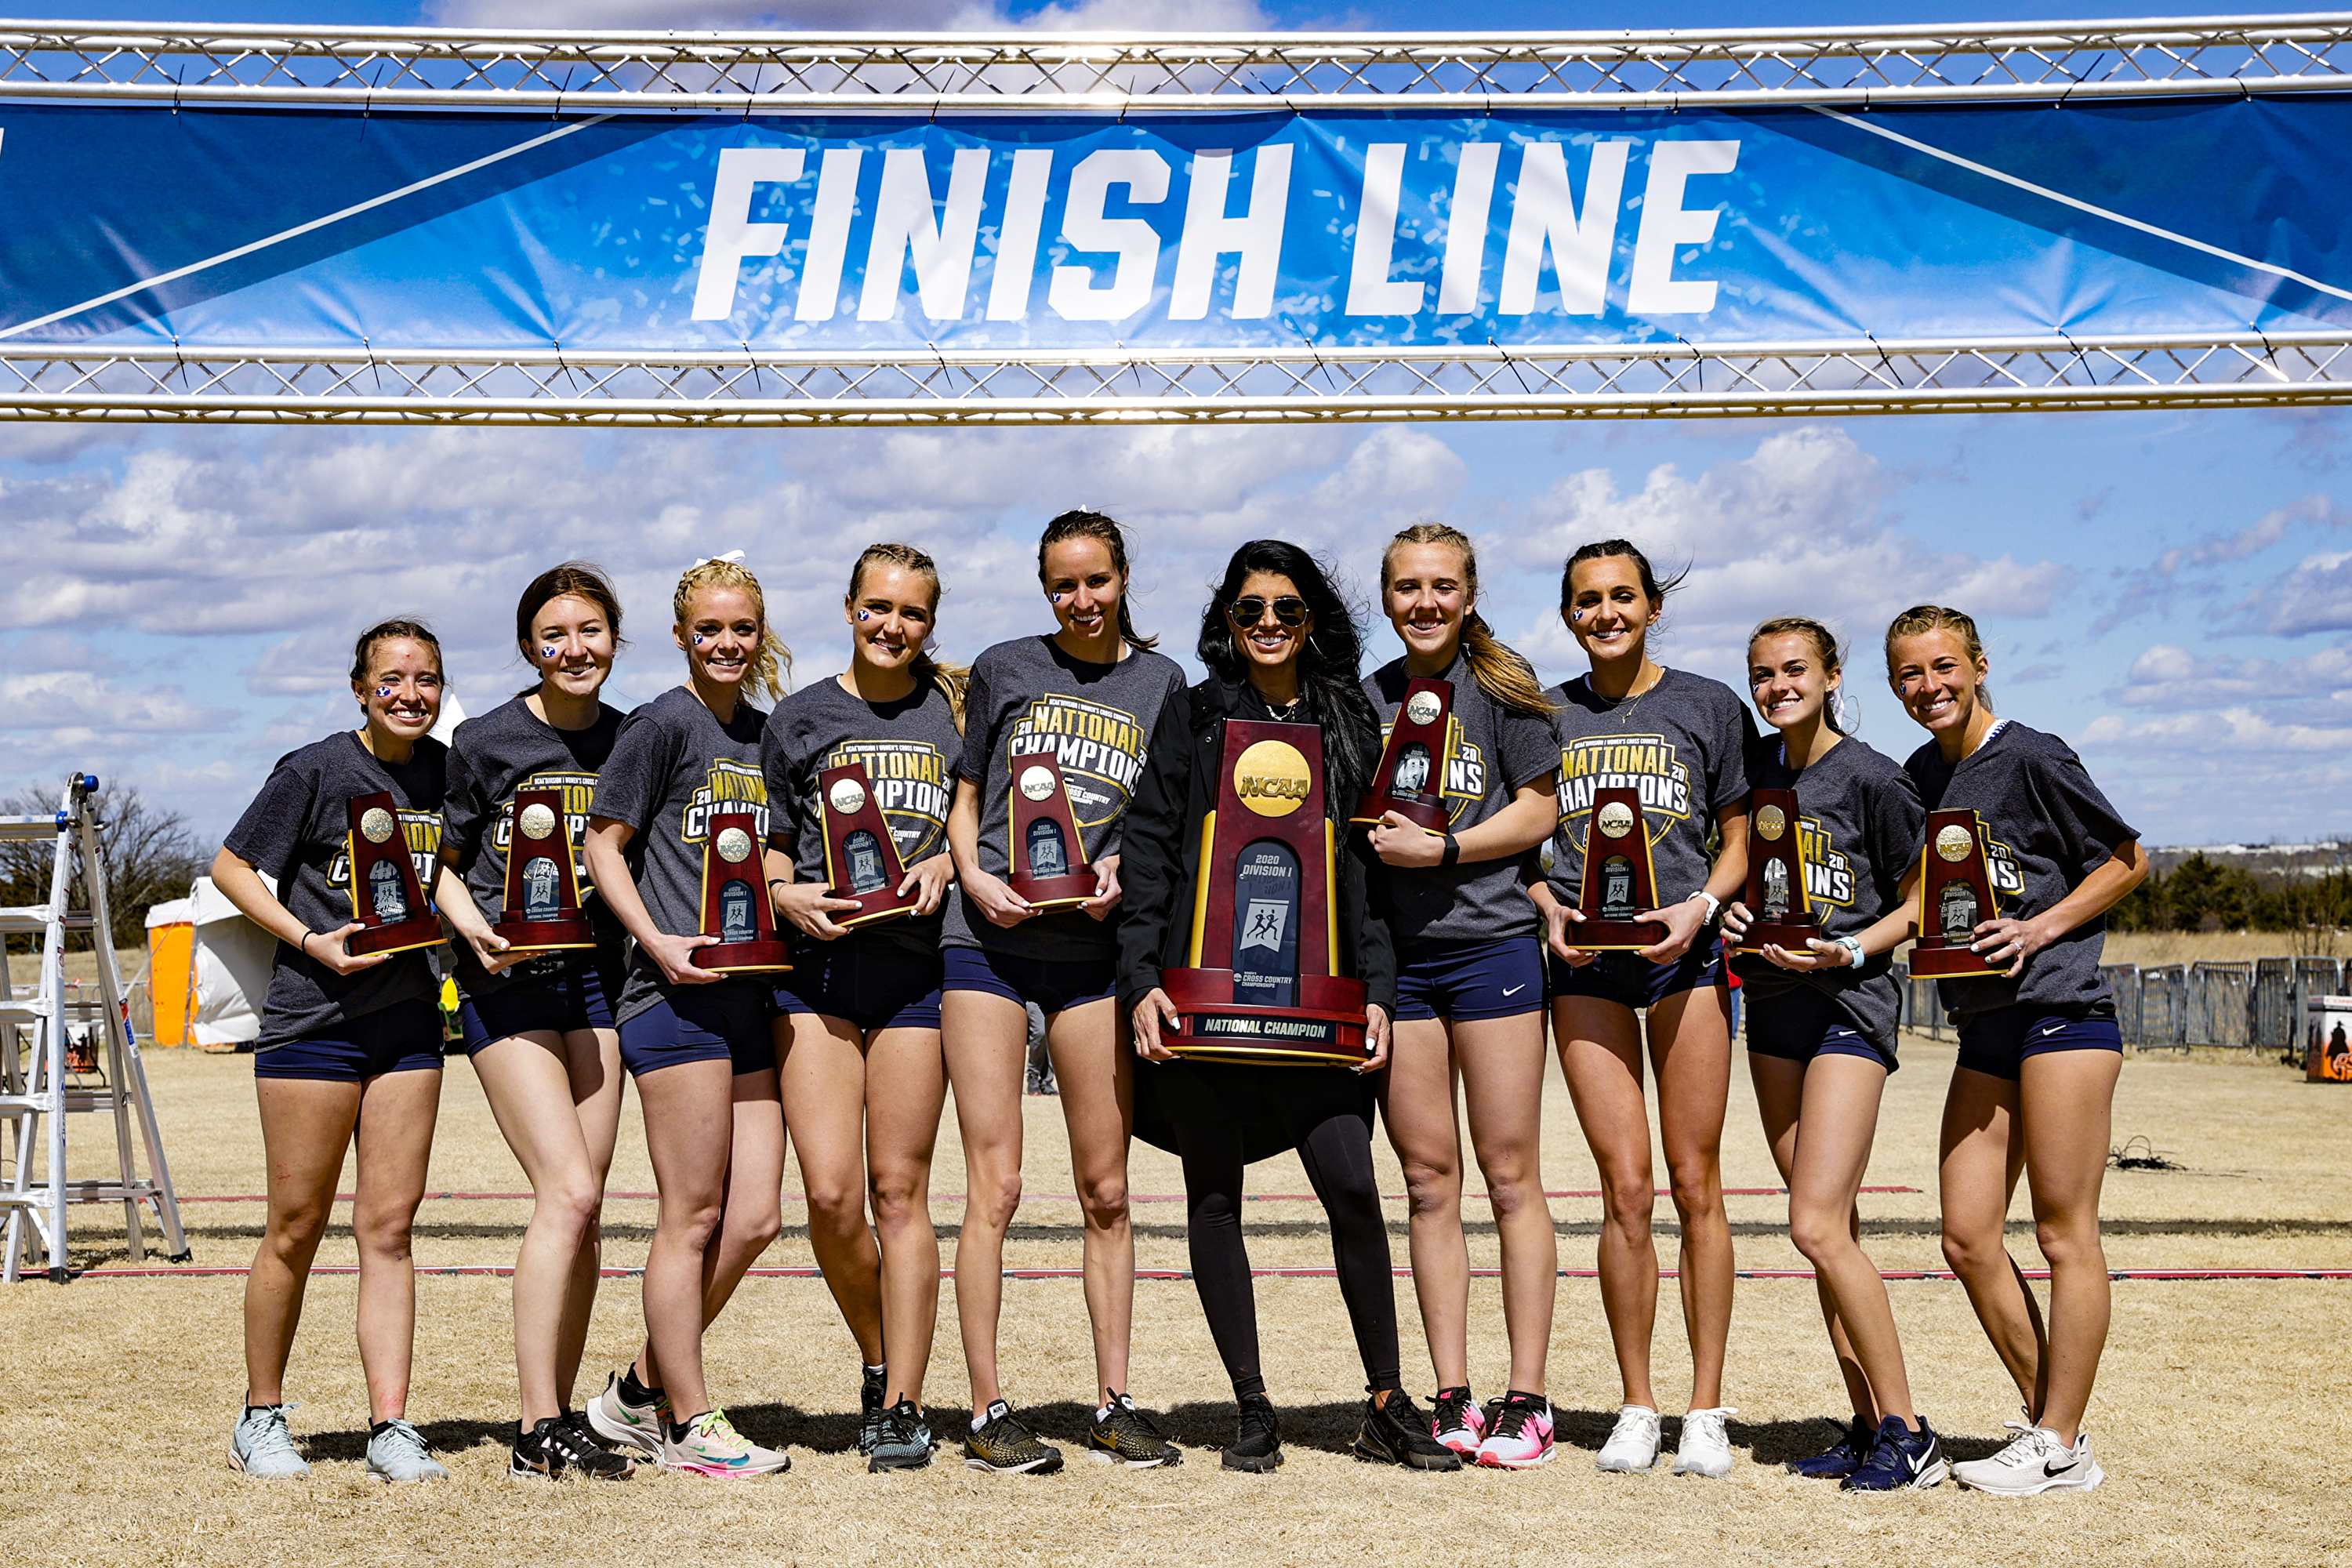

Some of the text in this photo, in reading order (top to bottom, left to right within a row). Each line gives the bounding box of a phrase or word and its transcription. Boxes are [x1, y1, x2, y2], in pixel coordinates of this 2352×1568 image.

[691, 140, 1740, 321] FINISH LINE
[543, 647, 554, 657] Y
[377, 686, 389, 697] Y
[1410, 705, 1438, 717] NCAA
[1018, 706, 1148, 768] 20 NATIONAL 20
[1462, 746, 1477, 762] 20
[1011, 734, 1143, 797] CHAMPIONS
[1562, 746, 1669, 781] NATIONAL
[1671, 765, 1685, 782] 20
[697, 771, 768, 805] 20 NATION
[1024, 782, 1054, 793] NCAA
[1240, 774, 1308, 802] NCAA
[835, 793, 865, 808] NCAA
[1068, 788, 1110, 804] OSS COUNTRY
[1556, 775, 1686, 816] HAMONS
[1601, 819, 1630, 829] NCAA
[893, 829, 920, 839] COUNTRY
[1939, 840, 1973, 854] NCAA
[1990, 845, 2007, 859] 20
[1255, 855, 1279, 865] 2020
[1828, 854, 1844, 870] 20
[1243, 864, 1292, 877] DIVISION I
[1265, 975, 1292, 985] COUNTRY
[1205, 1018, 1327, 1039] NATIONAL CHAMPION
